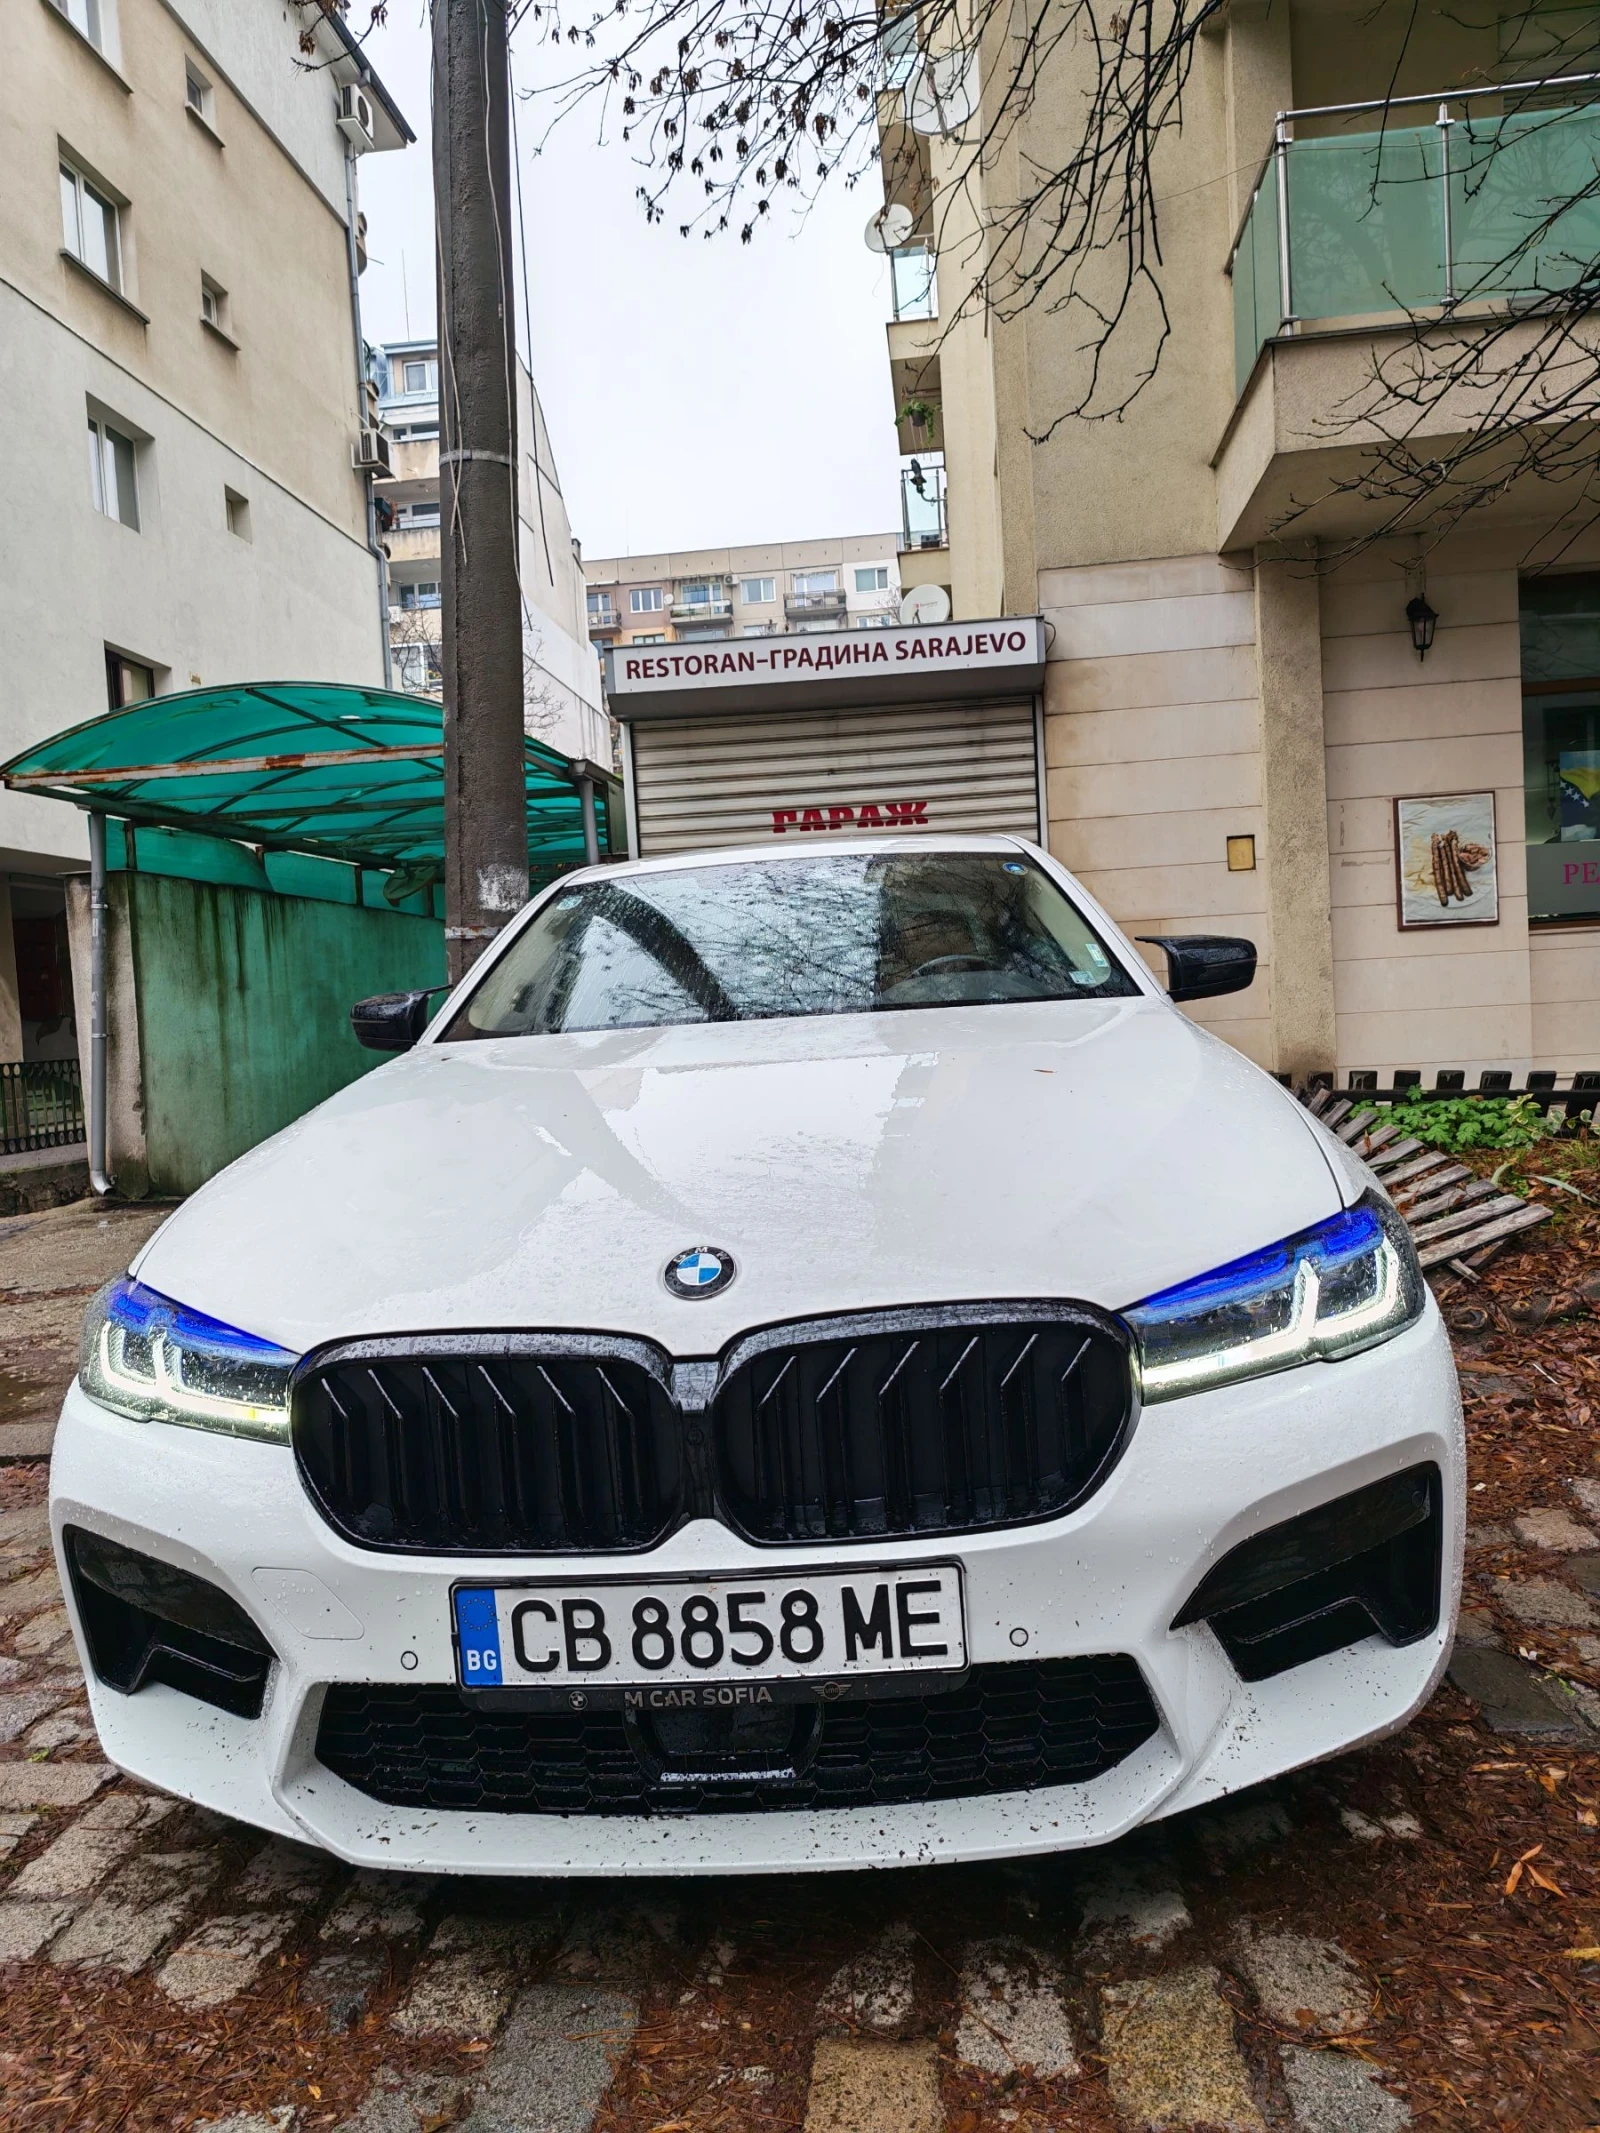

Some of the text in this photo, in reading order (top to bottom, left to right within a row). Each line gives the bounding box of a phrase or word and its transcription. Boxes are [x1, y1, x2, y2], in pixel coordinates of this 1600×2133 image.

[895, 631, 1027, 661] SARAJEVO
[772, 801, 929, 833] ГАРАЖ
[511, 1579, 949, 1673] CB 8858 ME
[467, 1649, 498, 1671] BG
[624, 1686, 773, 1708] M CAR SOFIA
